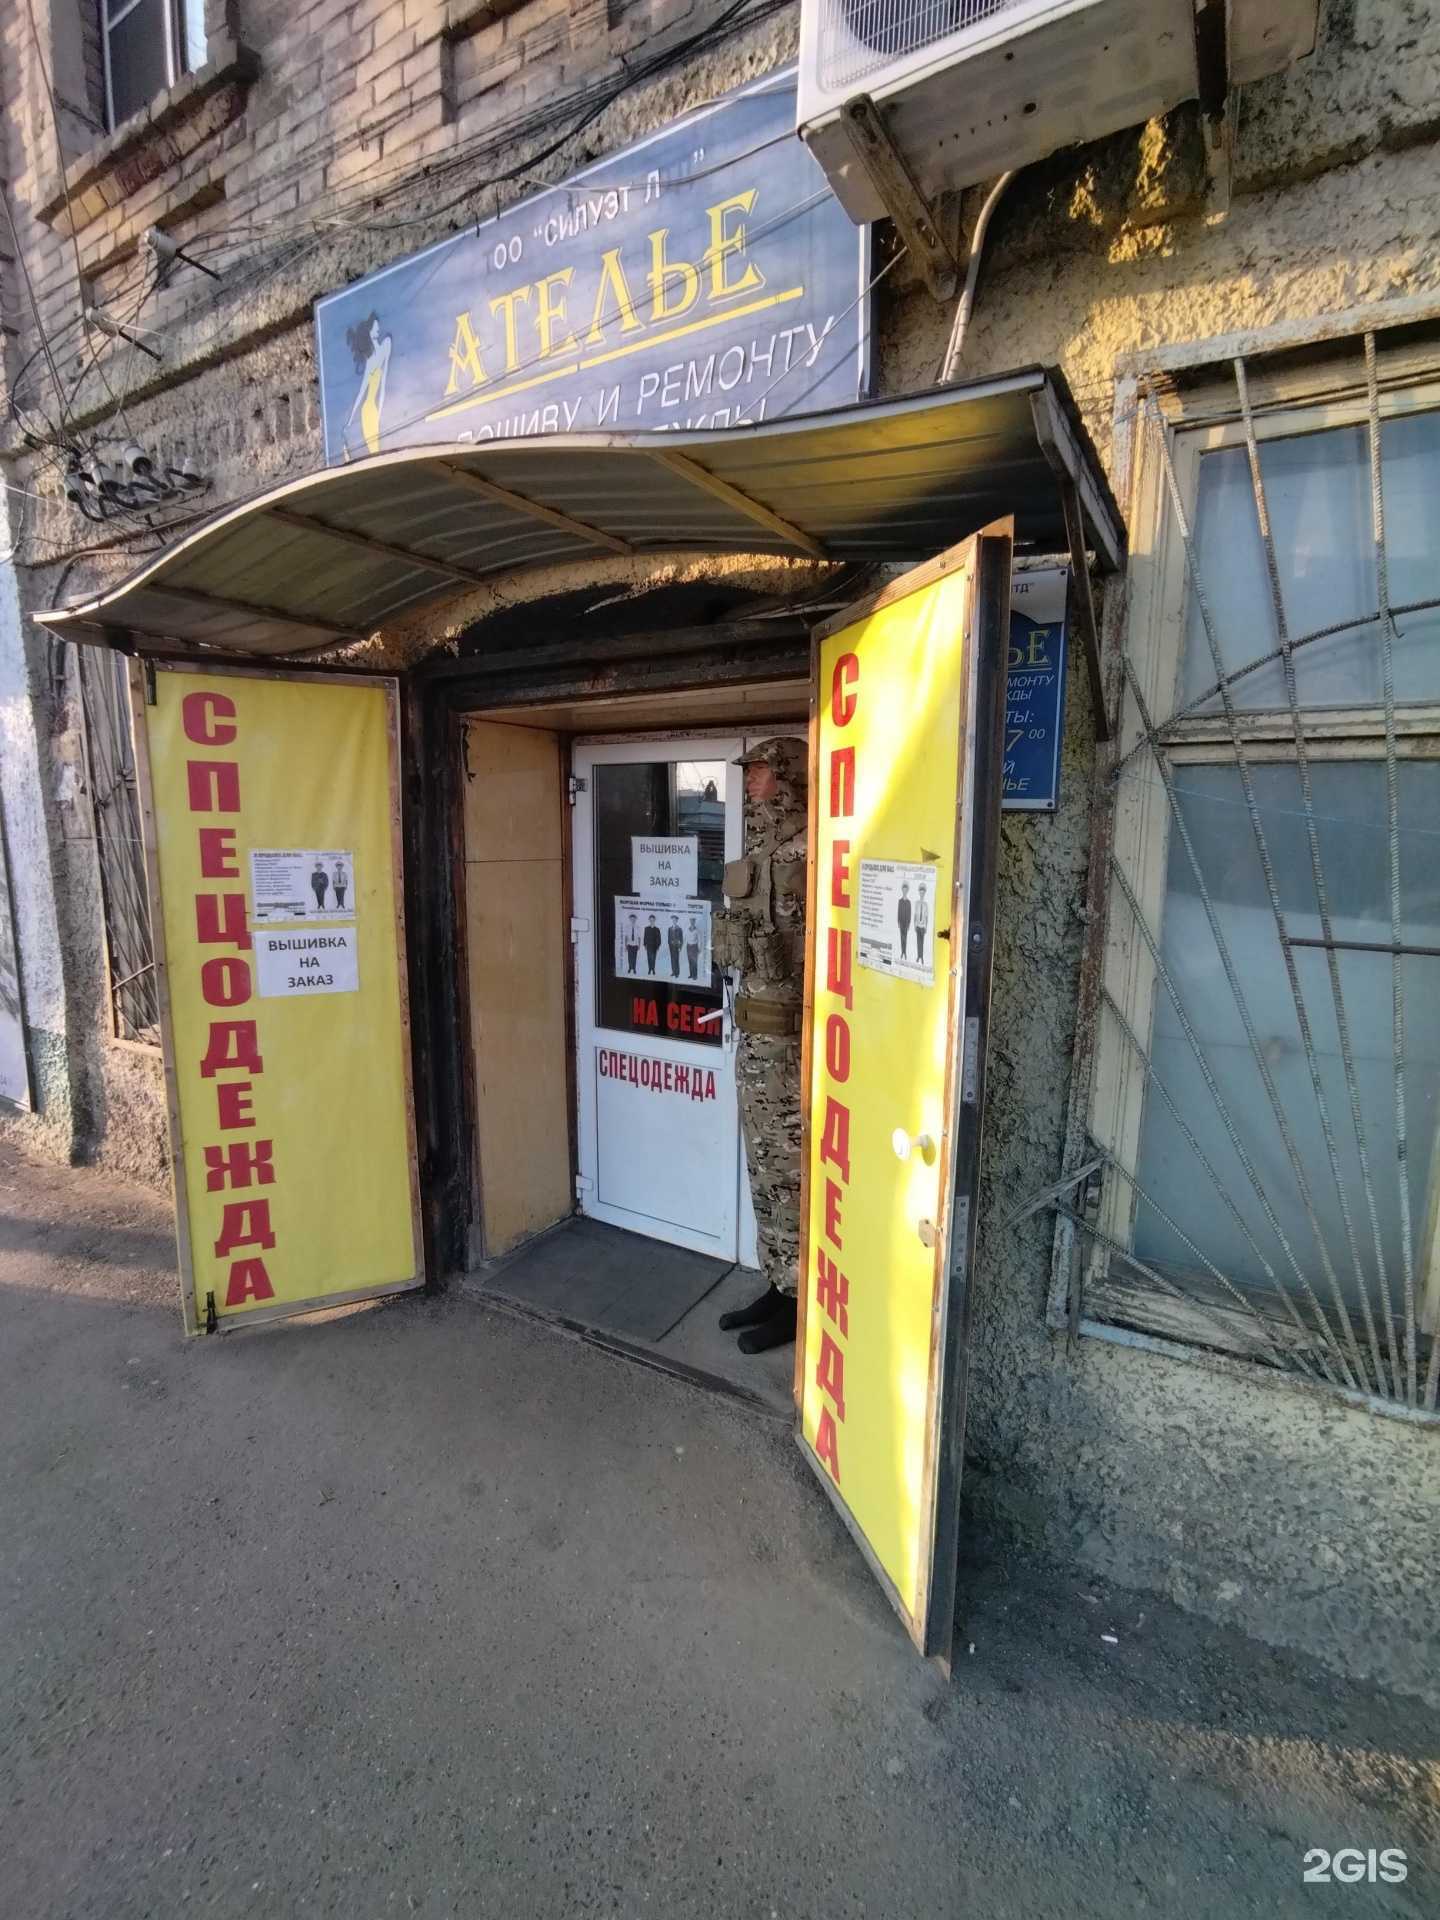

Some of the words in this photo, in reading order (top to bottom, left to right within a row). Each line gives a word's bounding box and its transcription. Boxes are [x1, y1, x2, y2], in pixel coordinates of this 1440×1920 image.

[443, 187, 767, 397] АТЕЛЬЕ
[598, 384, 621, 427] И
[636, 316, 835, 416] РЕМОНТУ
[1007, 674, 1055, 687] МОНТУ
[640, 843, 692, 855] ВЫШИВКА
[658, 860, 672, 871] НА
[649, 876, 680, 888] ЗАКАЗ
[268, 936, 348, 952] ВЫШИВКА
[299, 956, 321, 968] НА
[287, 974, 335, 989] ЗАКАЗ
[182, 691, 277, 1307] СПЕЦОДЕЖДА
[633, 997, 659, 1027] НА
[599, 1050, 717, 1103] СПЕЦОДЕЖДА
[816, 651, 860, 1486] СПЕЦОДЕЖДА
